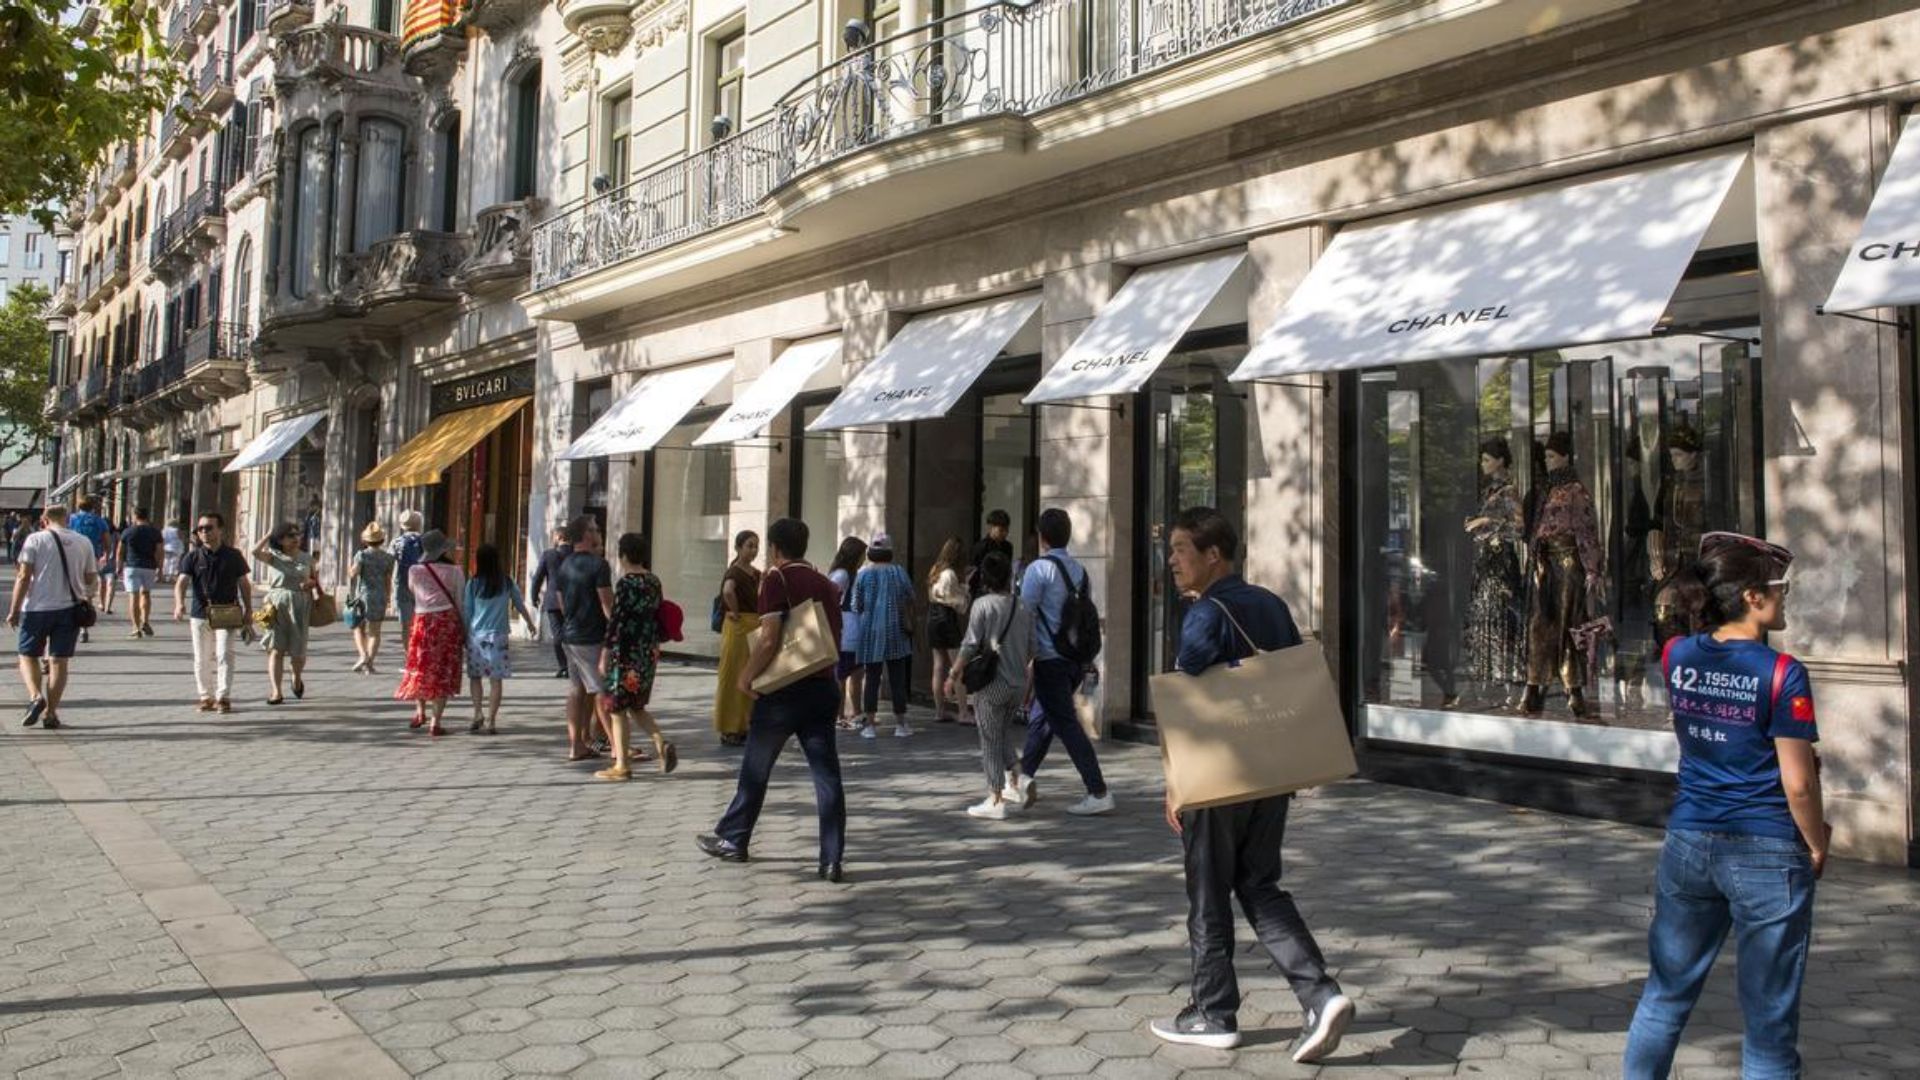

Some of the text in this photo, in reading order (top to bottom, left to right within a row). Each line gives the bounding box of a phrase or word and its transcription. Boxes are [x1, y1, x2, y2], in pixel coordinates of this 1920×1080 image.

[1387, 305, 1512, 333] CHANEL
[1071, 350, 1150, 372] CHANEL
[455, 376, 508, 402] BVLGARI
[873, 385, 933, 402] CHANEL
[1671, 665, 1759, 692] 42.195KM
[1697, 685, 1758, 703] MARATHON
